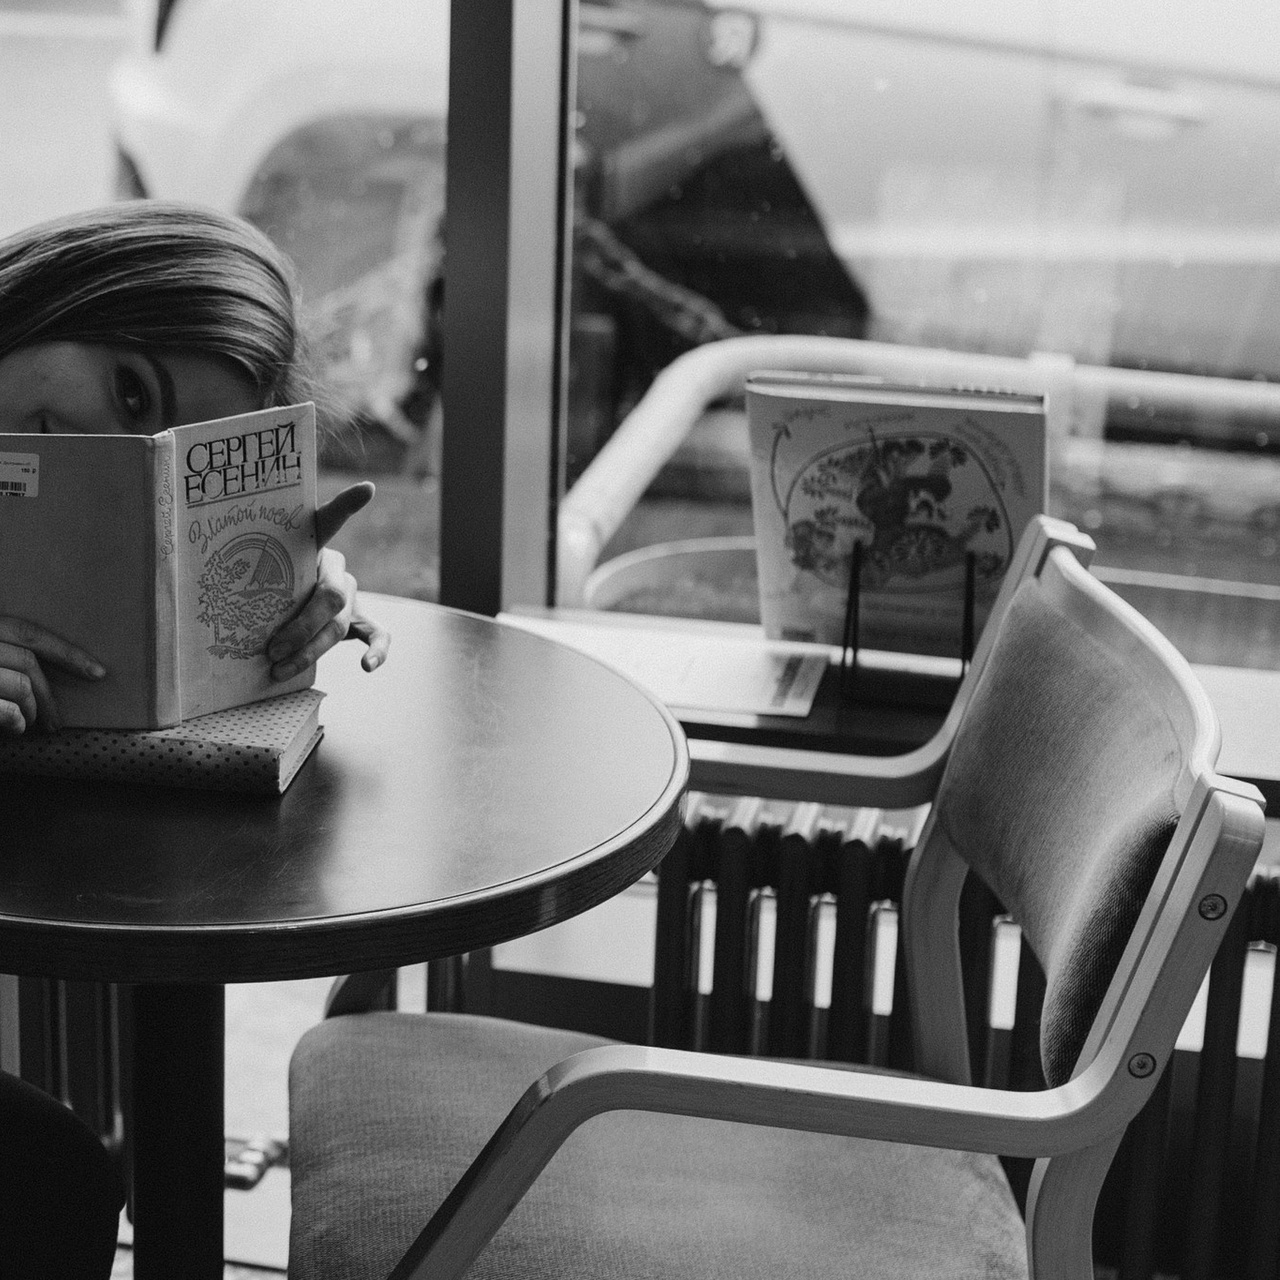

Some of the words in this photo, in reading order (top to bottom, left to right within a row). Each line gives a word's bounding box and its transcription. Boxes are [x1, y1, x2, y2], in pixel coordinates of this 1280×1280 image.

[186, 421, 296, 474] СЕРГЕЙ
[184, 451, 302, 505] ЕСЕНИН
[188, 500, 257, 554] Златой
